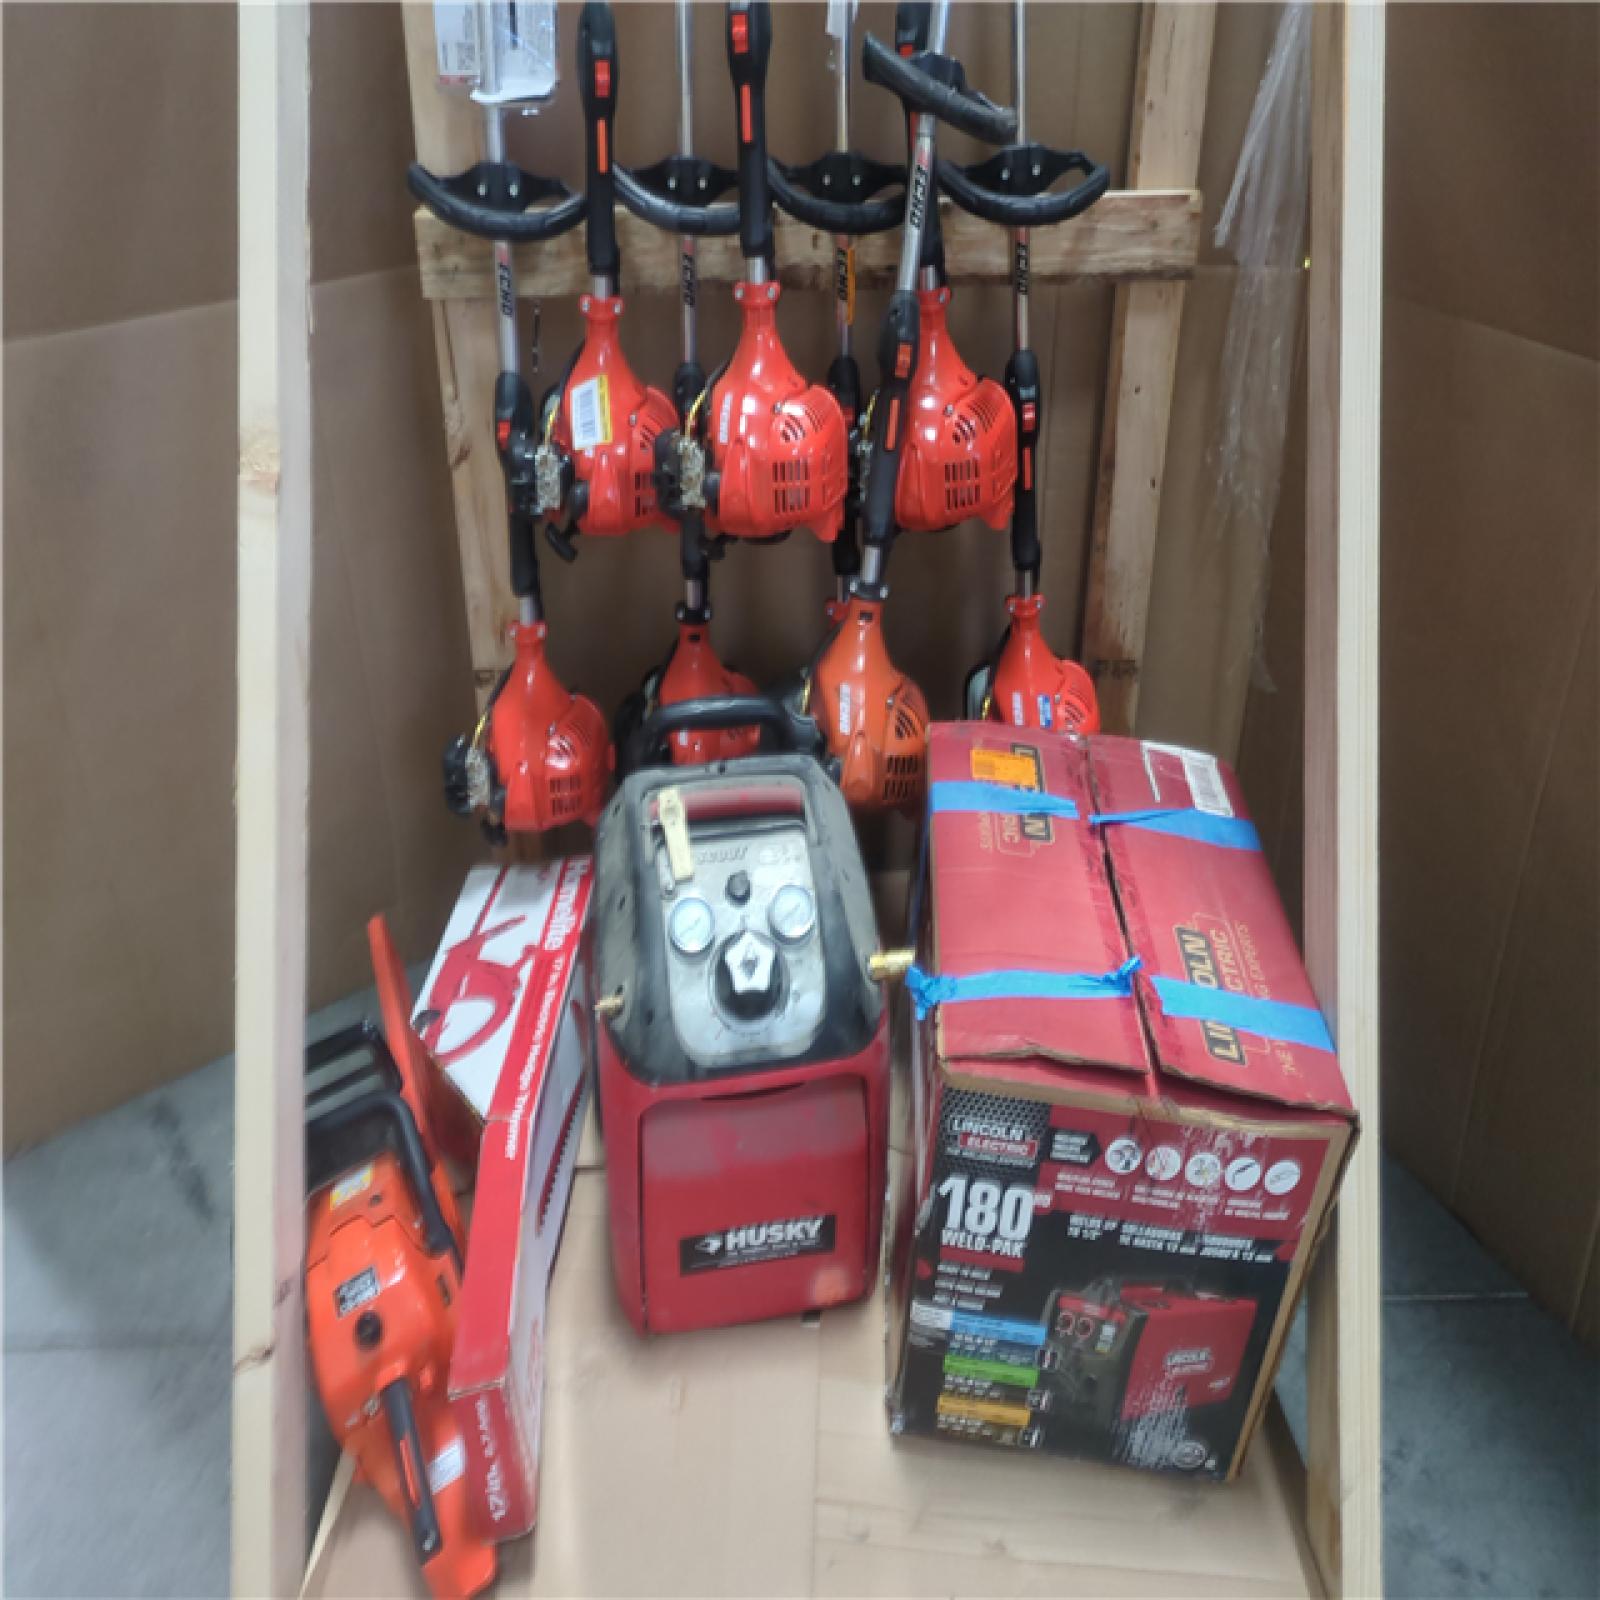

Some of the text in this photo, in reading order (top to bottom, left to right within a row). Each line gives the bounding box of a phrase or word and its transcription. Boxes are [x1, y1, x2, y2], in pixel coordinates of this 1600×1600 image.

[909, 164, 928, 229] ECHO
[1210, 928, 1243, 991] CTRIC
[1182, 934, 1240, 1060] LIOLN
[951, 1117, 1026, 1141] LINCOLN
[726, 1216, 825, 1250] HUSKY
[938, 1175, 1034, 1240] 180
[942, 1229, 1026, 1258] WELD-PAK
